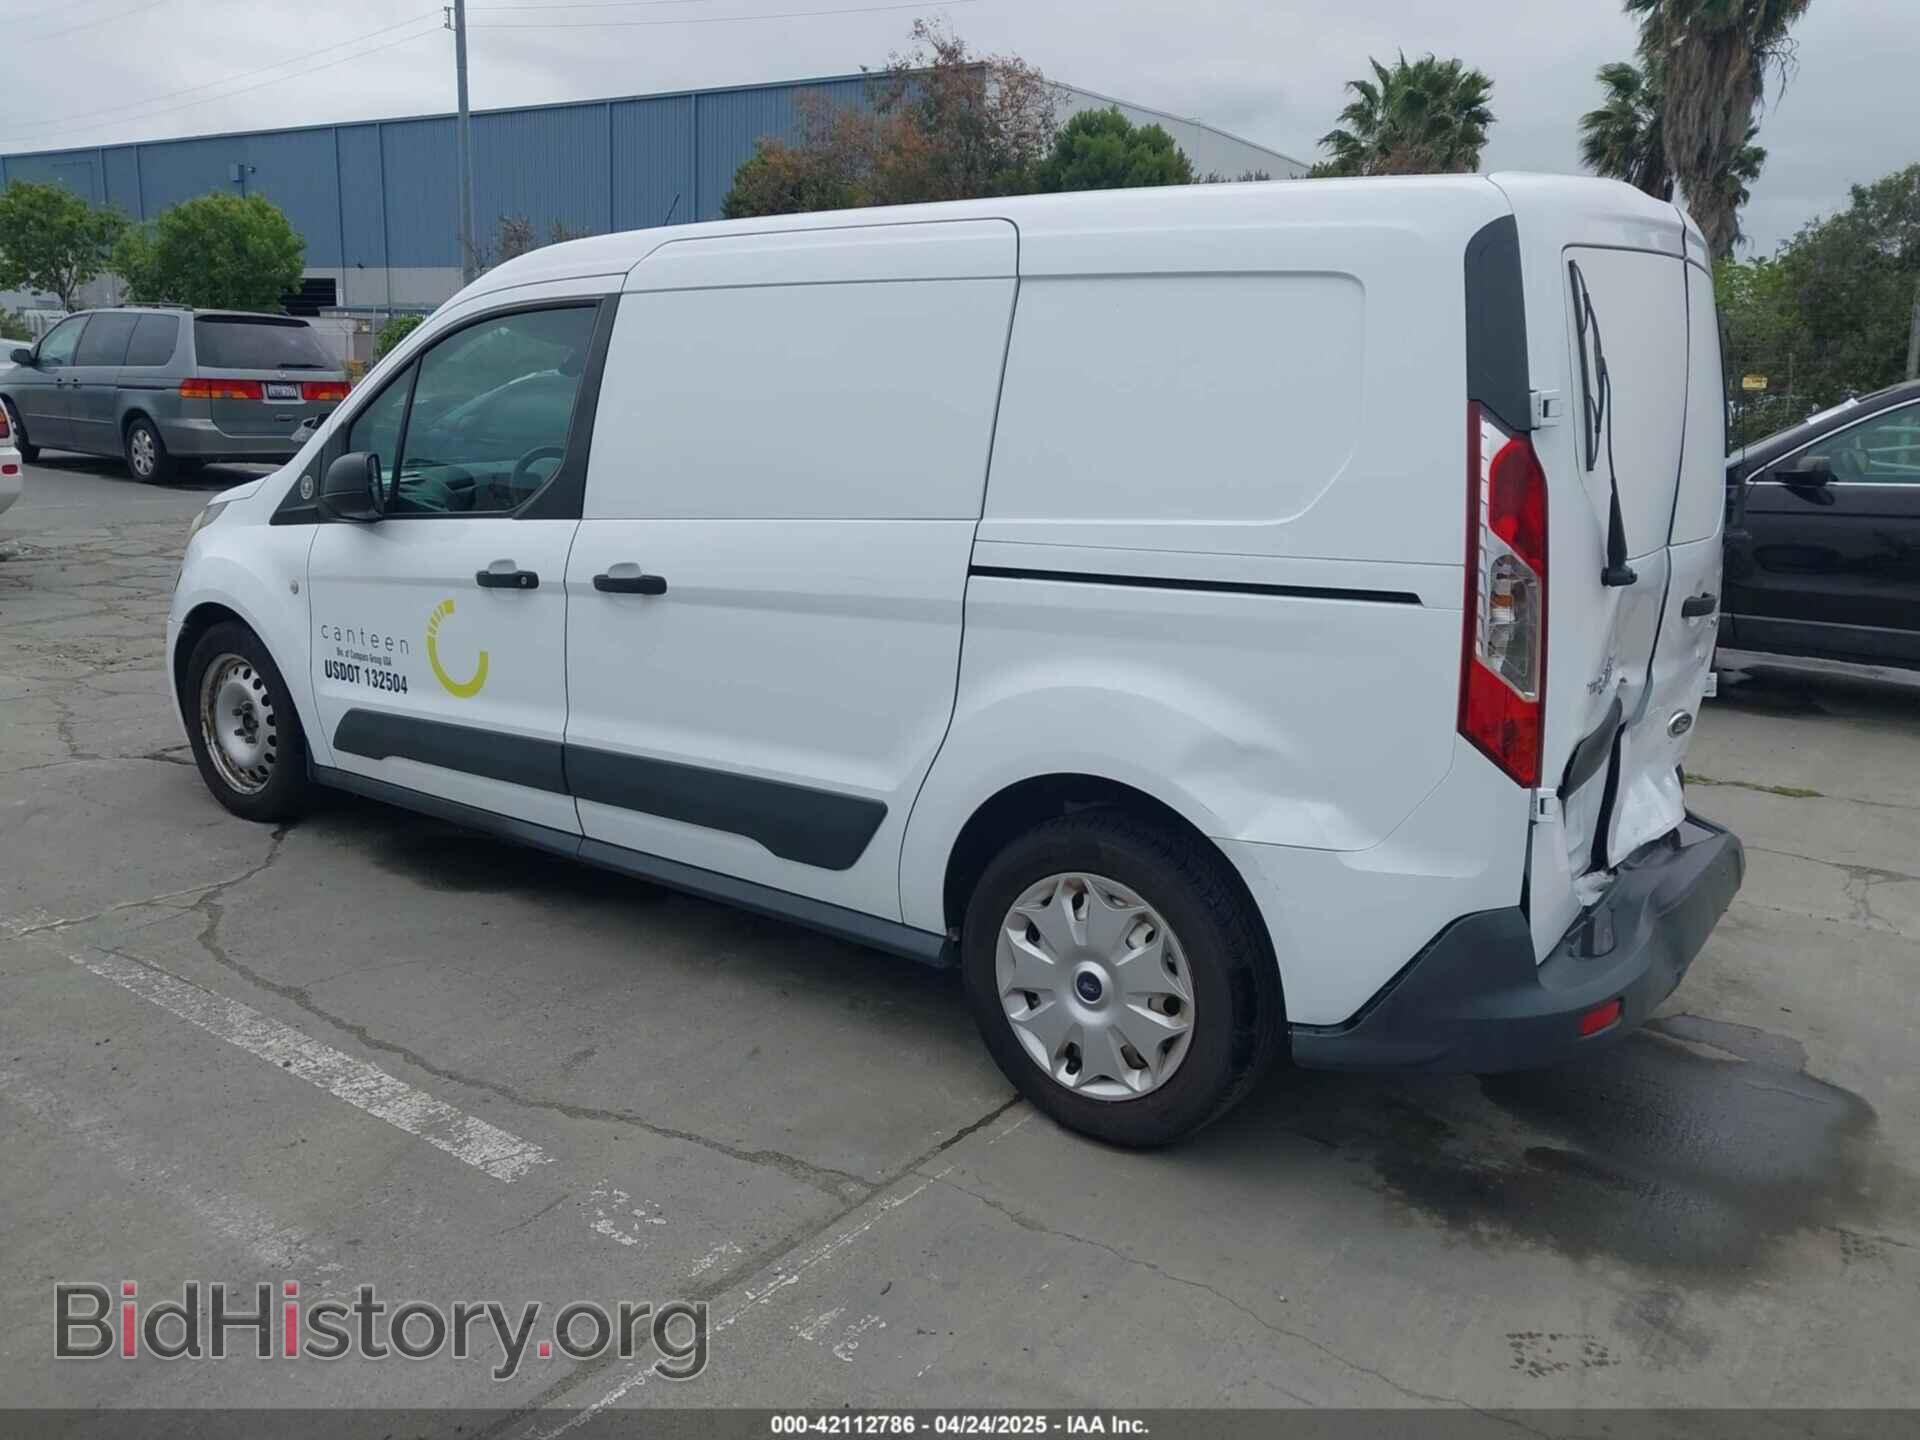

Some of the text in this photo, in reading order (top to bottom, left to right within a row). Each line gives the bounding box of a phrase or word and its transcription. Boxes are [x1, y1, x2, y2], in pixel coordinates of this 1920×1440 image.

[320, 624, 409, 656] canteen
[324, 658, 409, 695] USDOT 132504
